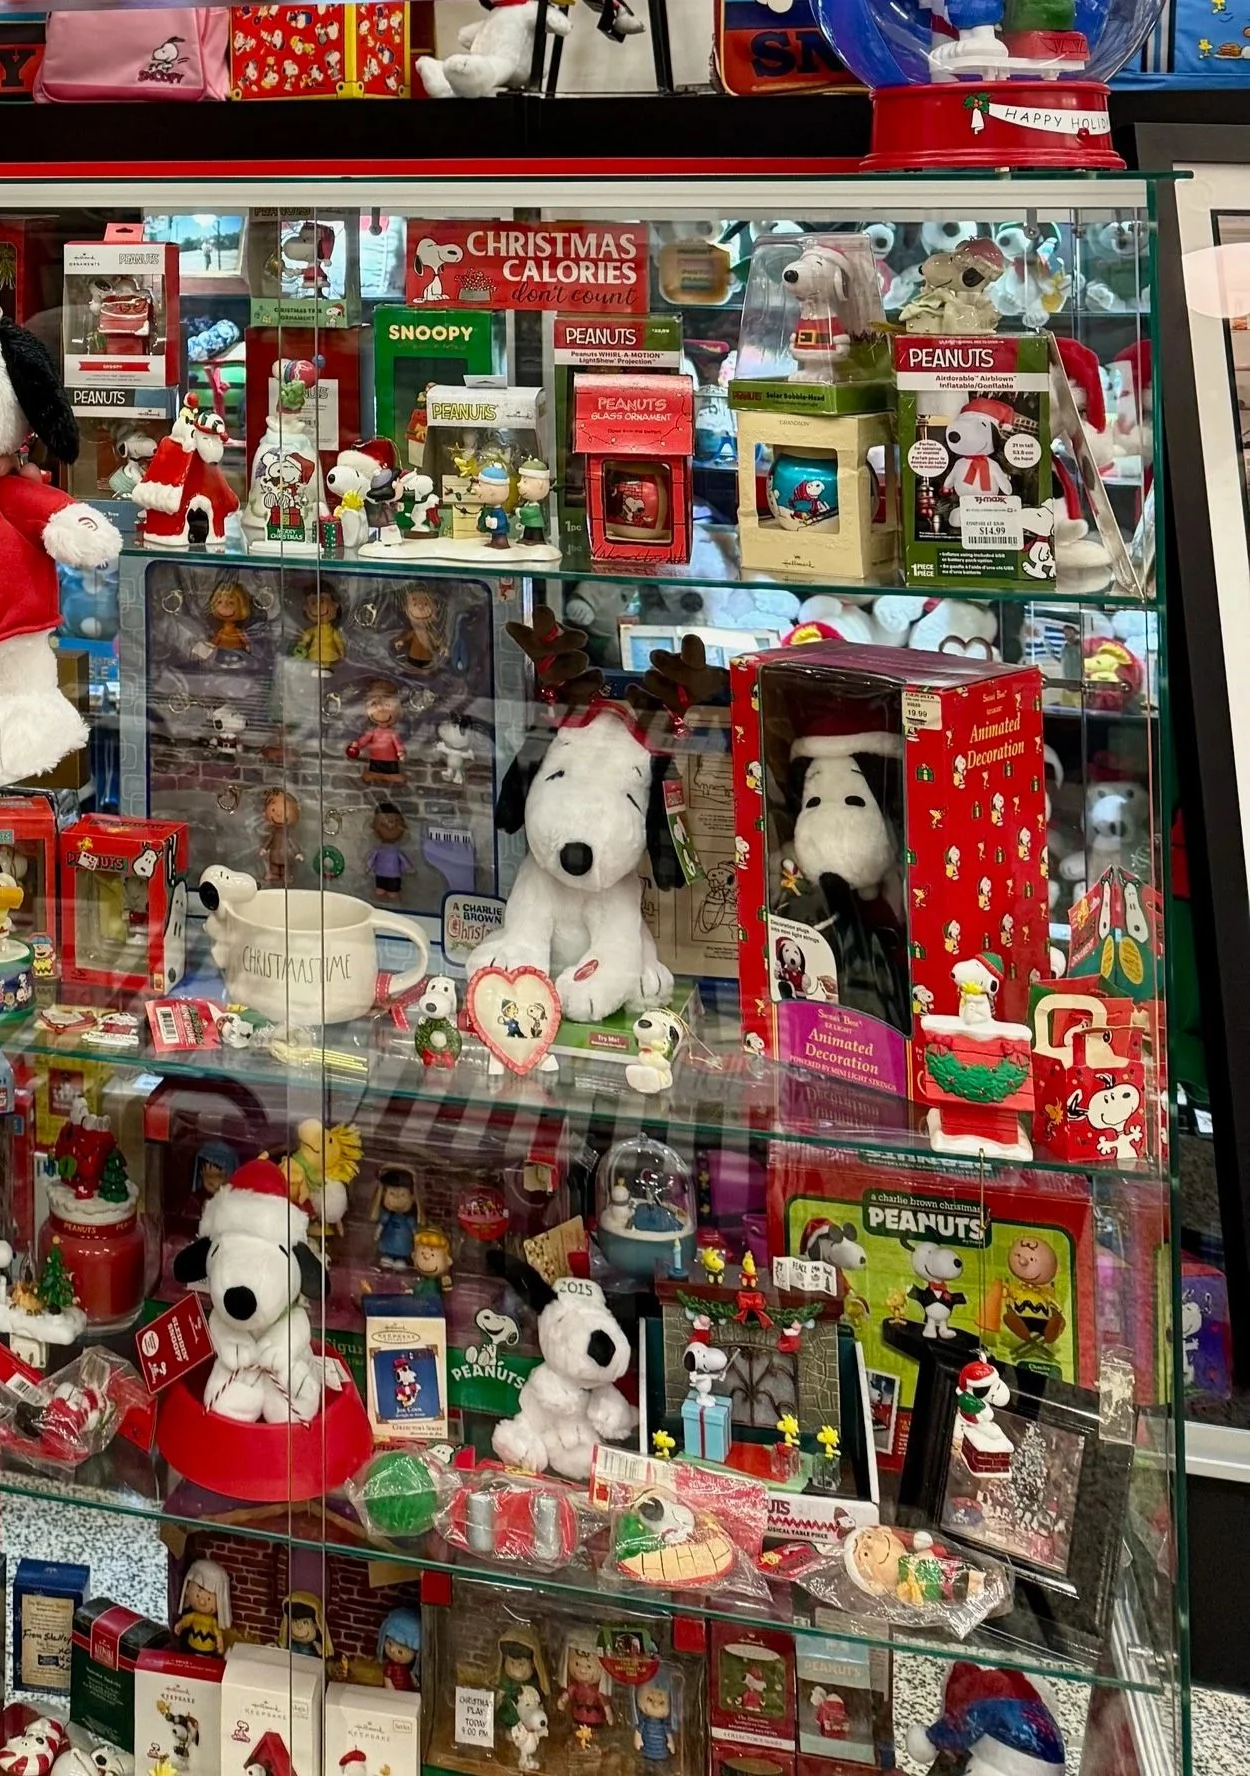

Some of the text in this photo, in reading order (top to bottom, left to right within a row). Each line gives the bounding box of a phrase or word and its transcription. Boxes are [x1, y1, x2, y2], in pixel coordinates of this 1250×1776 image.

[1004, 107, 1063, 128] HAPPY
[466, 231, 637, 260] CHRISTMAS
[118, 253, 160, 265] PEANUTS
[503, 259, 638, 285] CALORIES
[511, 281, 638, 306] don't count
[388, 324, 474, 341] SNOOPY
[565, 328, 637, 346] PEANUTS
[909, 348, 995, 369] PEANUTS
[73, 389, 126, 405] PEANUTS
[597, 396, 667, 411] PEANUTS
[432, 402, 498, 421] PEANUTS
[590, 411, 673, 422] GLASS ORNAMENT
[565, 520, 582, 533] 1pc
[979, 526, 1006, 536] $14.99
[969, 715, 1021, 743] Animated
[967, 739, 1025, 770] Decoration
[67, 851, 124, 869] PUTS
[452, 902, 503, 916] A CHARLIE
[463, 912, 502, 925] BROWN
[808, 1027, 875, 1057] Animated
[805, 1043, 880, 1075] Decoration
[830, 1065, 846, 1078] MINI
[847, 1070, 869, 1084] LIGHT
[868, 1077, 898, 1092] STRINGS
[878, 1193, 909, 1205] charlie
[910, 1196, 938, 1208] brown
[63, 1221, 97, 1235] PEANUTS
[868, 1206, 984, 1240] PEANUTS
[559, 1280, 594, 1297] 2015
[450, 1362, 527, 1391] PEANUTS
[767, 1526, 791, 1535] USICAL
[23, 1628, 43, 1640] From
